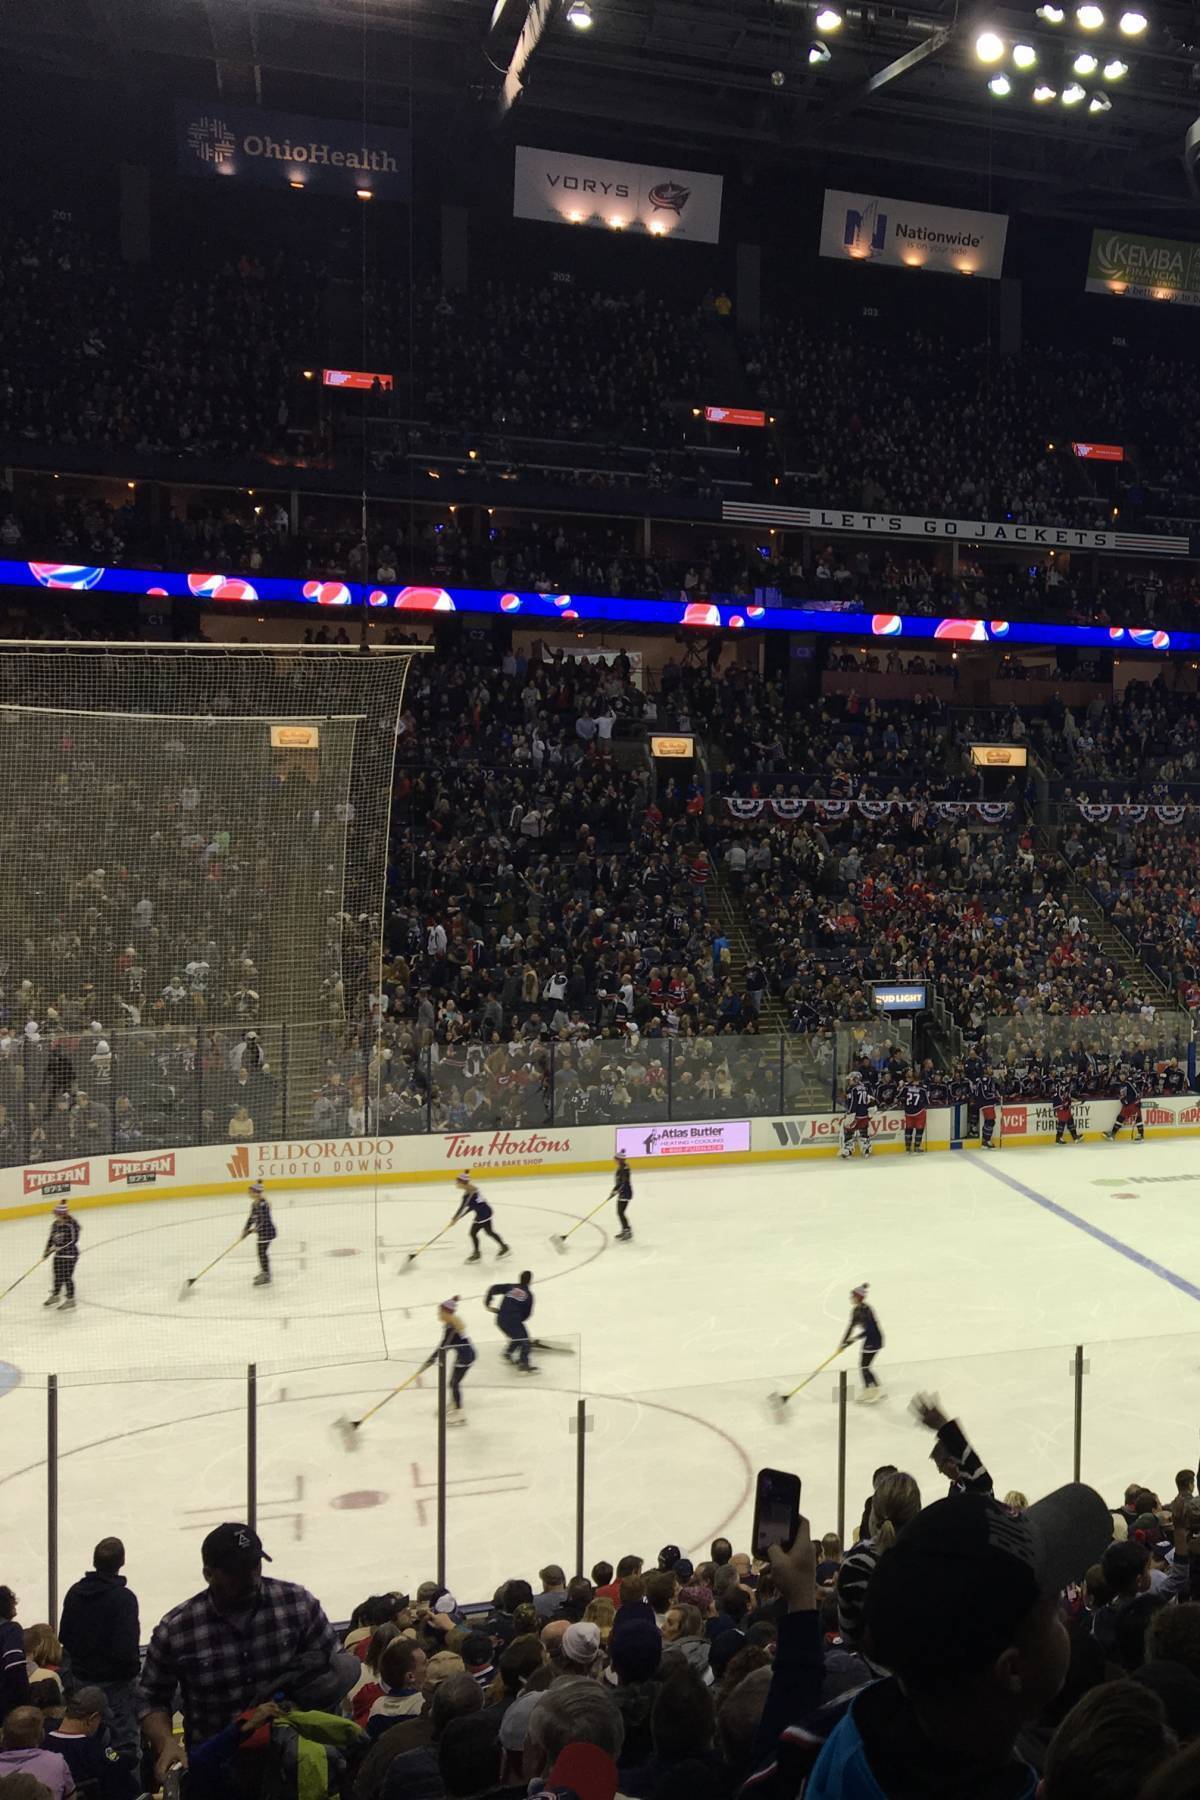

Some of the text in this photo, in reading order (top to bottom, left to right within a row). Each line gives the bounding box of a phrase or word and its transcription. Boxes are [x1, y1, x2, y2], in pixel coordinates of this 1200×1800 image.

[243, 136, 398, 172] OhioHealth
[547, 173, 628, 197] VORYS
[895, 223, 981, 248] Nationwide
[951, 245, 968, 255] side
[1113, 242, 1184, 272] KEMBA
[553, 271, 571, 282] 202
[1126, 266, 1182, 282] FINANCIAL
[821, 512, 1107, 547] LET'S GO JACKETS
[895, 993, 923, 1003] LIGHT
[906, 1092, 920, 1106] 27
[1003, 1115, 1026, 1127] VCF
[661, 1127, 724, 1139] Atlas Butler
[258, 1140, 394, 1160] ELDORADO
[444, 1131, 571, 1158] Tim Hortons
[112, 1157, 172, 1177] THE FAN
[258, 1158, 393, 1176] SCIOTO DOWNS
[473, 1160, 492, 1168] CAFÉ
[502, 1159, 521, 1167] BAKE
[523, 1158, 543, 1166] SHOP
[27, 1167, 86, 1188] THE FAN
